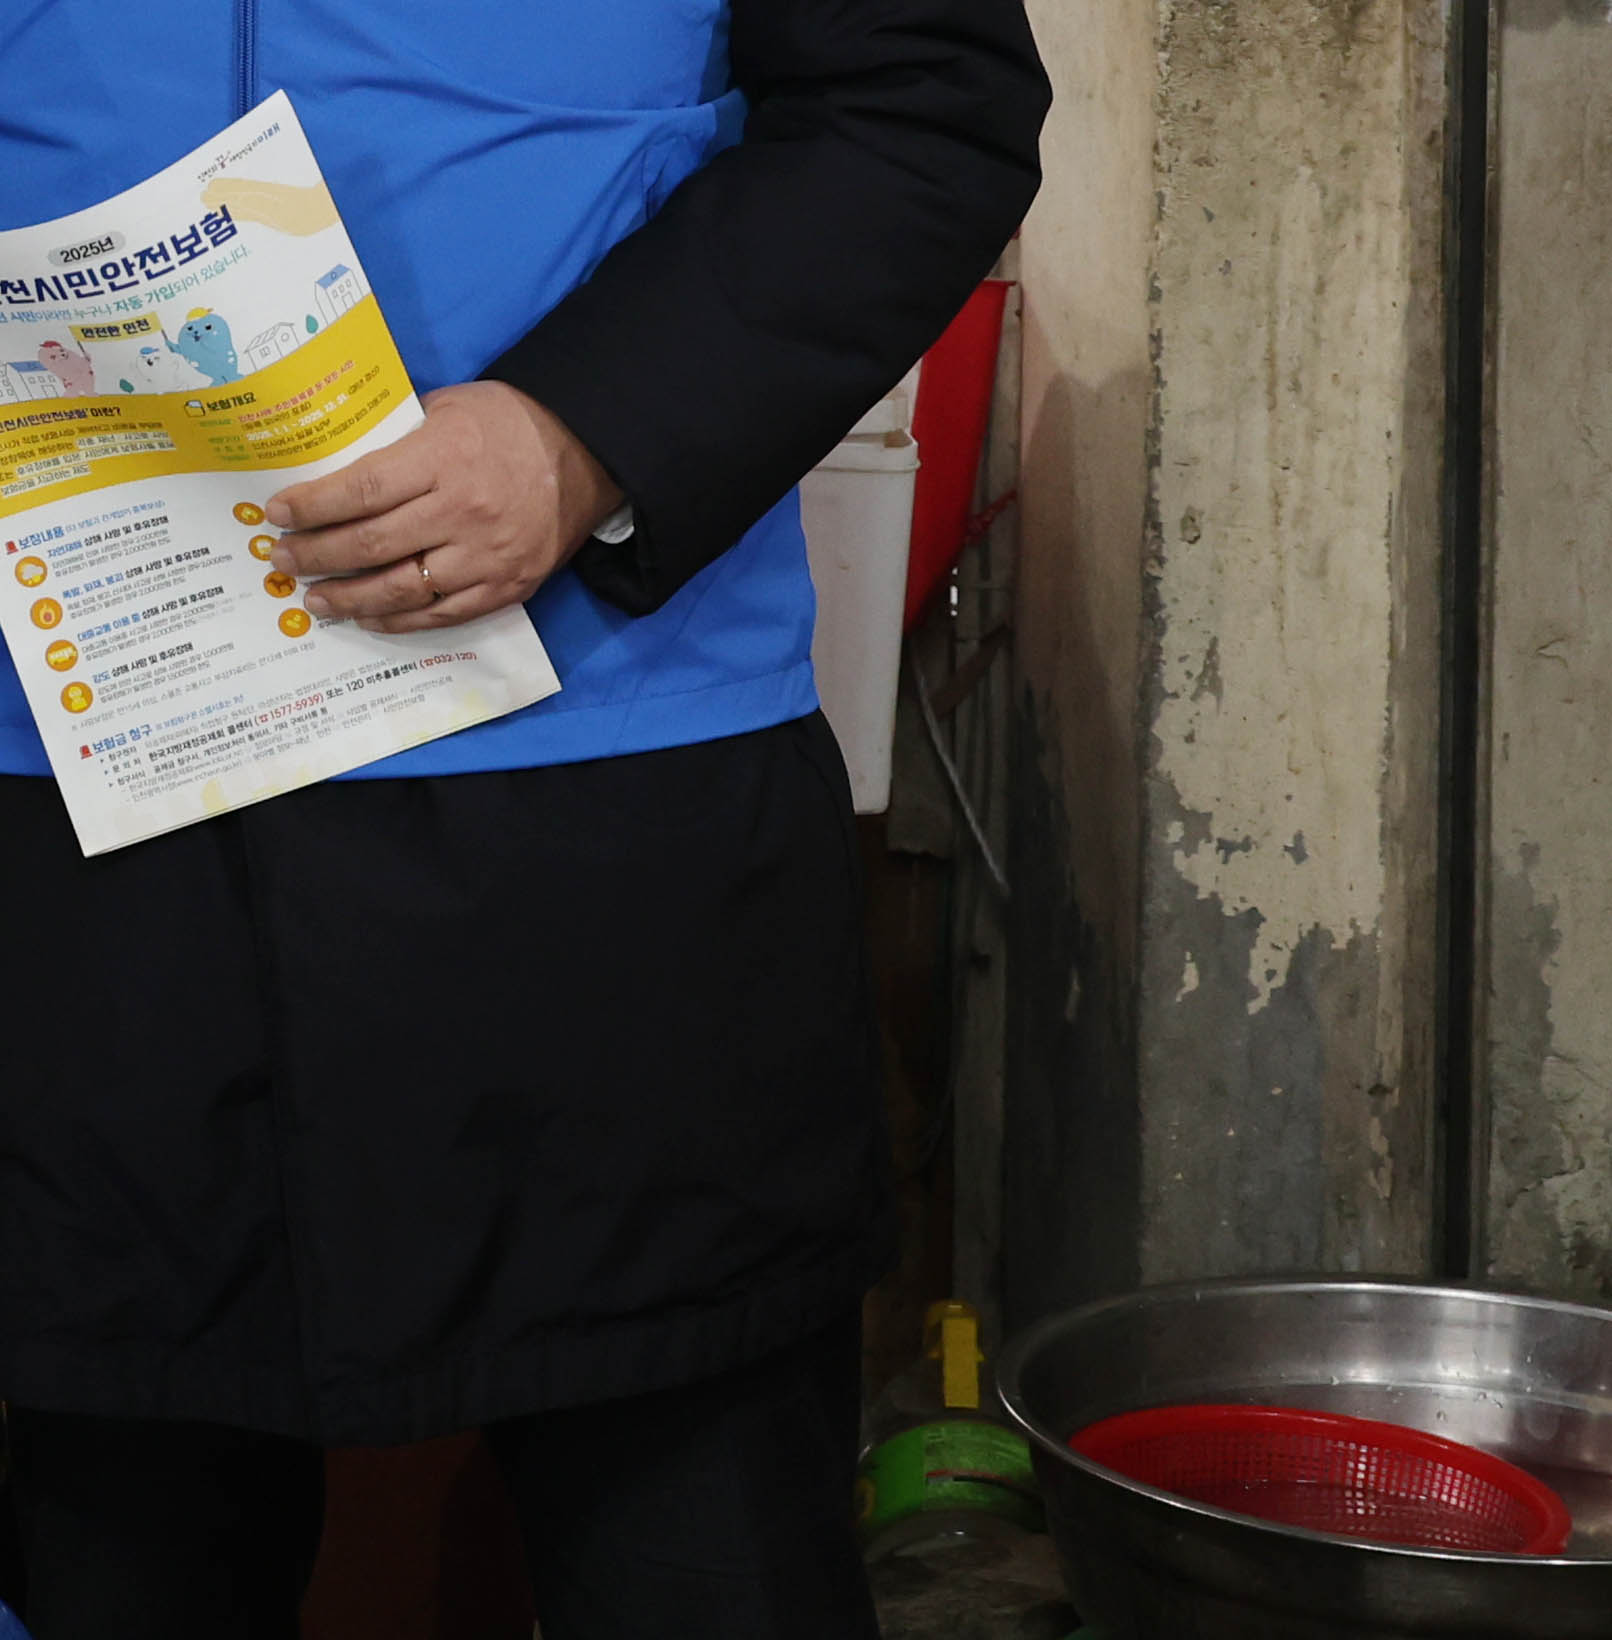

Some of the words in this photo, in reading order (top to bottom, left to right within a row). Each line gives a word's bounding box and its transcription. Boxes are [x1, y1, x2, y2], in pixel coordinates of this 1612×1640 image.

[60, 235, 114, 263] 2025년
[11, 308, 72, 323] 시민이라면
[74, 302, 114, 321] 누구나
[115, 296, 144, 315] 자동
[146, 276, 200, 307] 가입되어
[200, 244, 252, 286] 있습니다.
[81, 323, 119, 340] 안전한
[122, 318, 151, 335] 인천
[205, 389, 257, 413] 보험개요
[18, 524, 64, 548] 보장내용
[83, 533, 102, 547] 상해
[103, 528, 122, 542] 사망
[122, 525, 132, 536] 및
[133, 514, 169, 533] 후유장해
[125, 566, 144, 580] 상해
[144, 560, 163, 574] 사망
[163, 557, 174, 569] 및
[174, 546, 210, 565] 후유장해
[141, 606, 160, 620] 상해
[160, 600, 178, 614] 사망
[178, 597, 188, 608] 및
[189, 585, 224, 605] 후유장해
[111, 663, 129, 678] 상해
[130, 657, 148, 672] 사망
[148, 654, 158, 665] 및
[158, 641, 193, 662] 후유장해
[148, 727, 225, 762] 한국지방재정공제회
[226, 717, 253, 735] 콜센터
[325, 685, 343, 700] 또는
[346, 679, 364, 693] 120
[365, 660, 418, 686] 미추홀콜센터
[91, 731, 127, 754] 보험금
[128, 722, 152, 742] 청구
